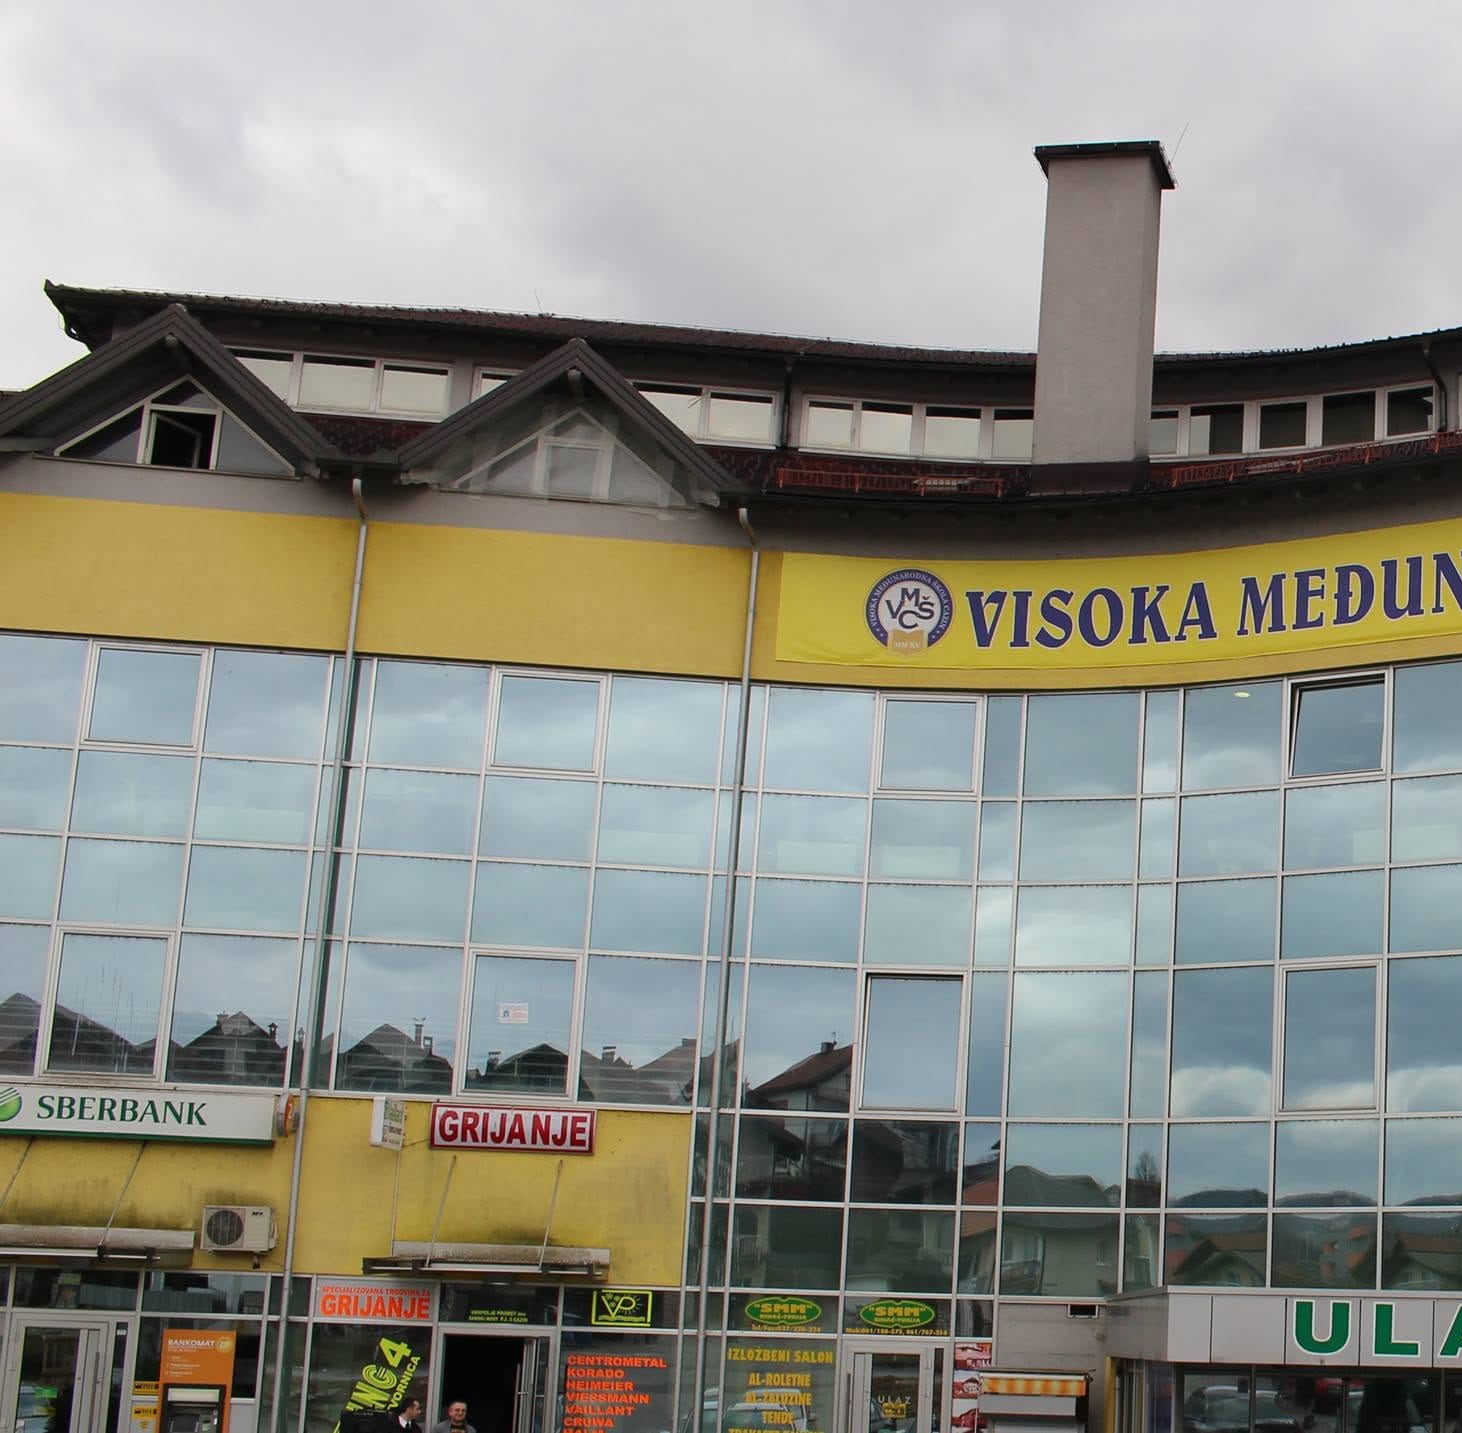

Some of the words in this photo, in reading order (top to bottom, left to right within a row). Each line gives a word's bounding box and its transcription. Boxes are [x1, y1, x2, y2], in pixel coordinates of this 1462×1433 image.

[966, 582, 1218, 649] VISOKA
[36, 1095, 208, 1126] SBERBANK
[438, 1110, 588, 1147] GRIJANJE
[320, 1294, 431, 1319] GRIJANJE
[168, 1338, 216, 1348] BANKOMAT
[379, 1337, 412, 1368] 4
[793, 1350, 834, 1364] SALON
[567, 1354, 668, 1369] CENTROMETAL
[567, 1368, 625, 1379] KORADO
[748, 1372, 812, 1386] AL-ROLETNE
[566, 1380, 634, 1391] HEIMEIER
[565, 1392, 650, 1404] VIESSMANN
[564, 1404, 635, 1416] VAILLANT
[761, 1411, 795, 1425] TENDE
